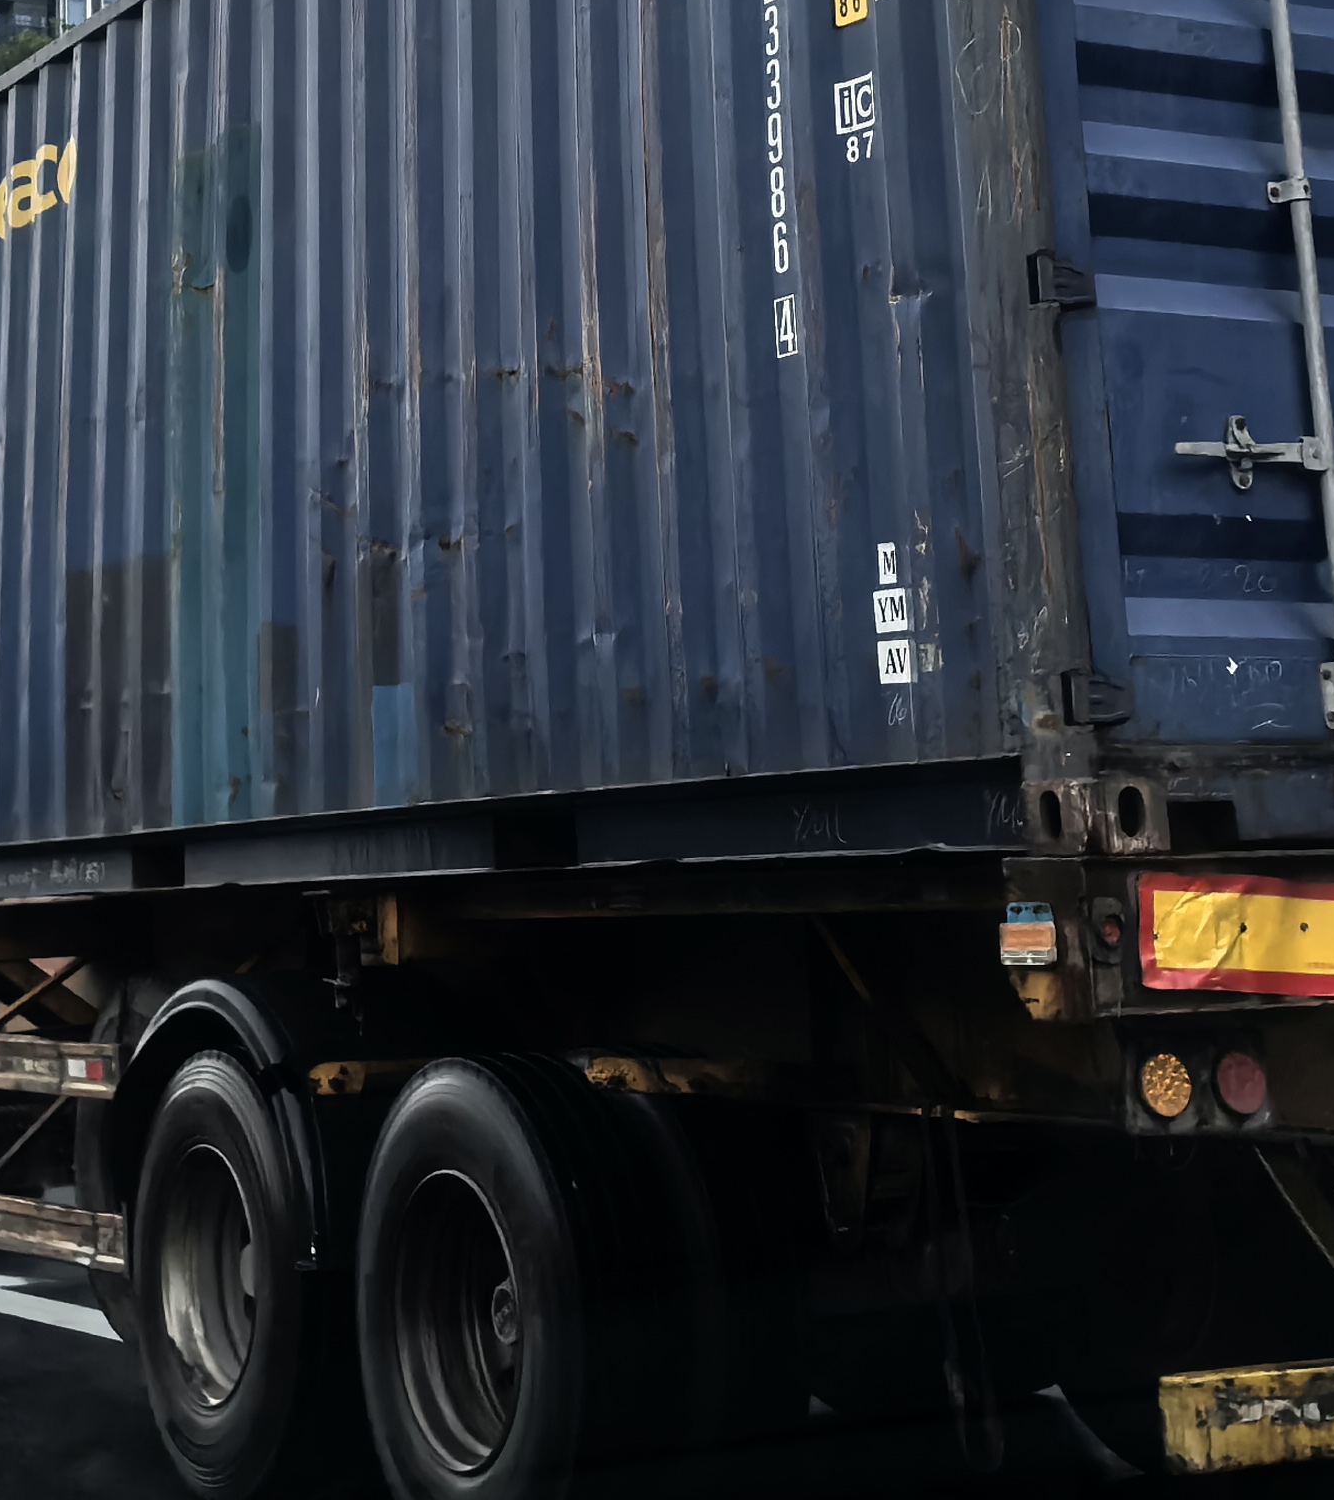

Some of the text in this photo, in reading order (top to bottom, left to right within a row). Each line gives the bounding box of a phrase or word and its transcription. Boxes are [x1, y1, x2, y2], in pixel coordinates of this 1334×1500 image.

[846, 131, 874, 163] 87
[882, 550, 896, 575] M
[877, 595, 906, 622] YM
[884, 647, 907, 675] AV
